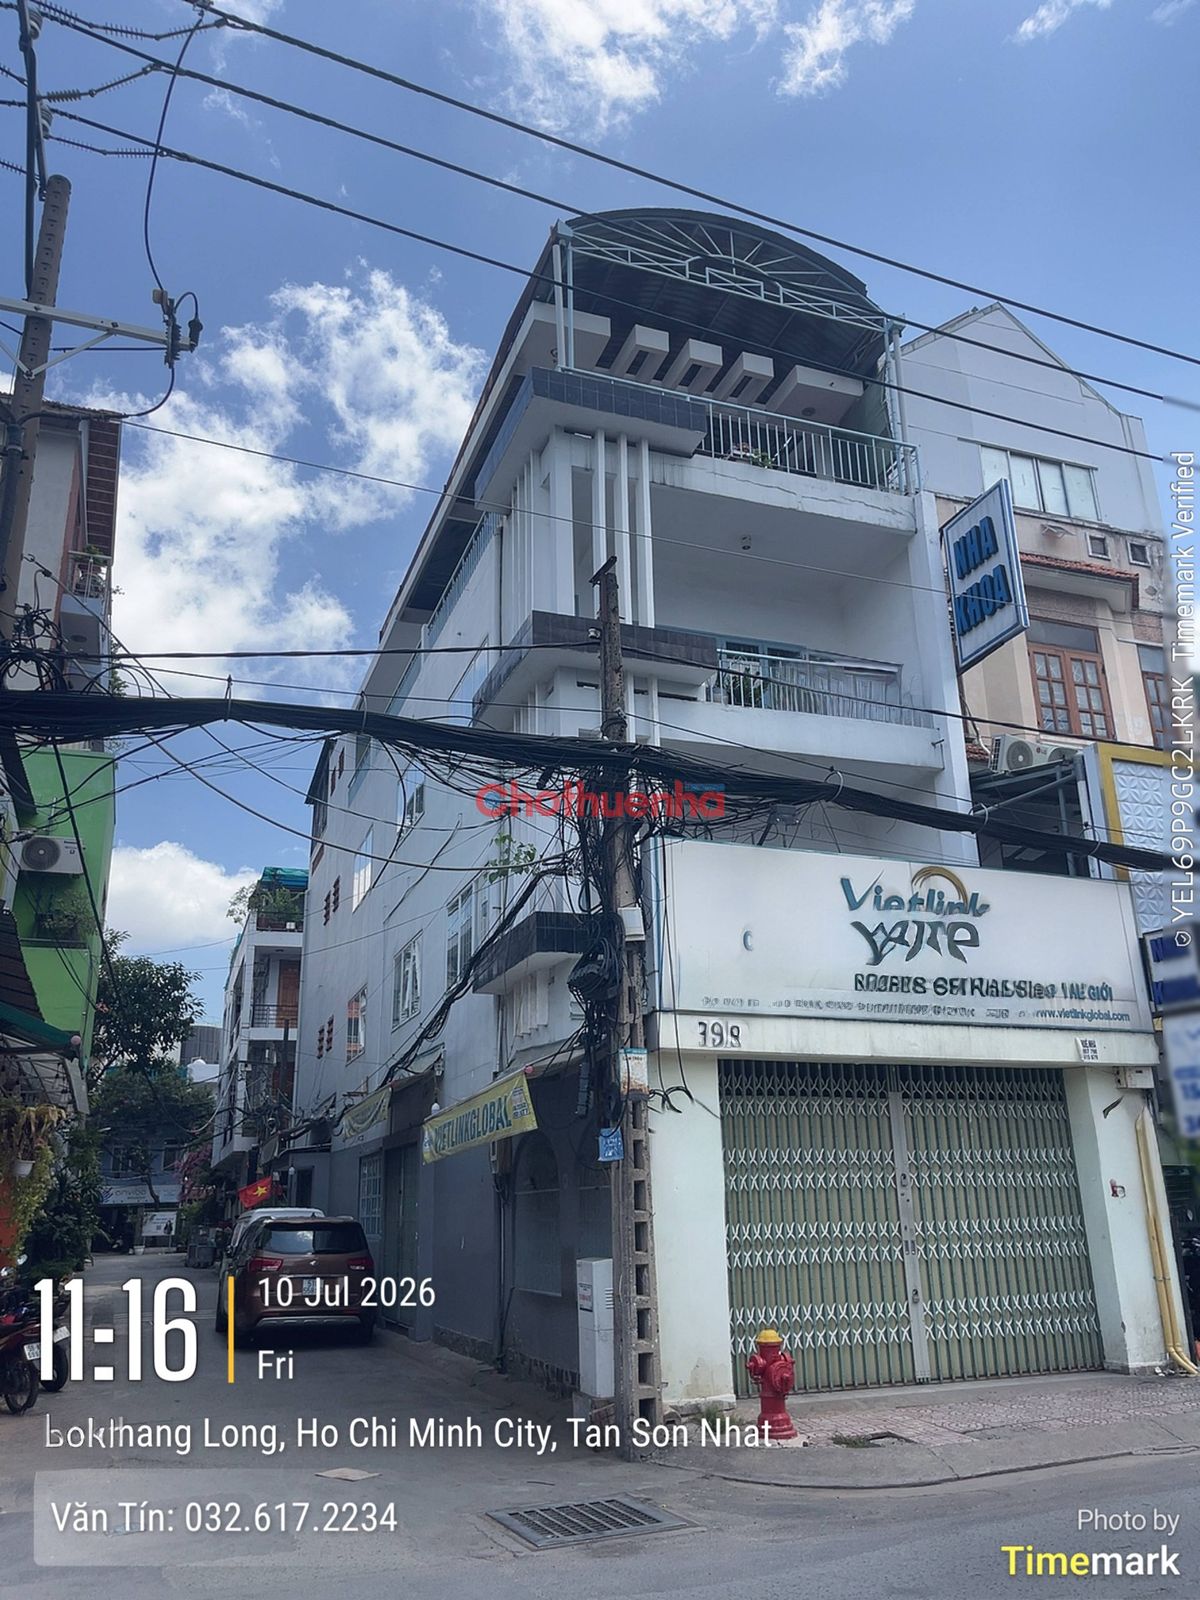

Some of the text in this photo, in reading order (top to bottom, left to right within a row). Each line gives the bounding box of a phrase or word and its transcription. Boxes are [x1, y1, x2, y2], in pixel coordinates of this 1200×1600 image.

[953, 516, 998, 580] NHA
[955, 564, 1012, 636] KHOA
[839, 868, 990, 917] Vietlink
